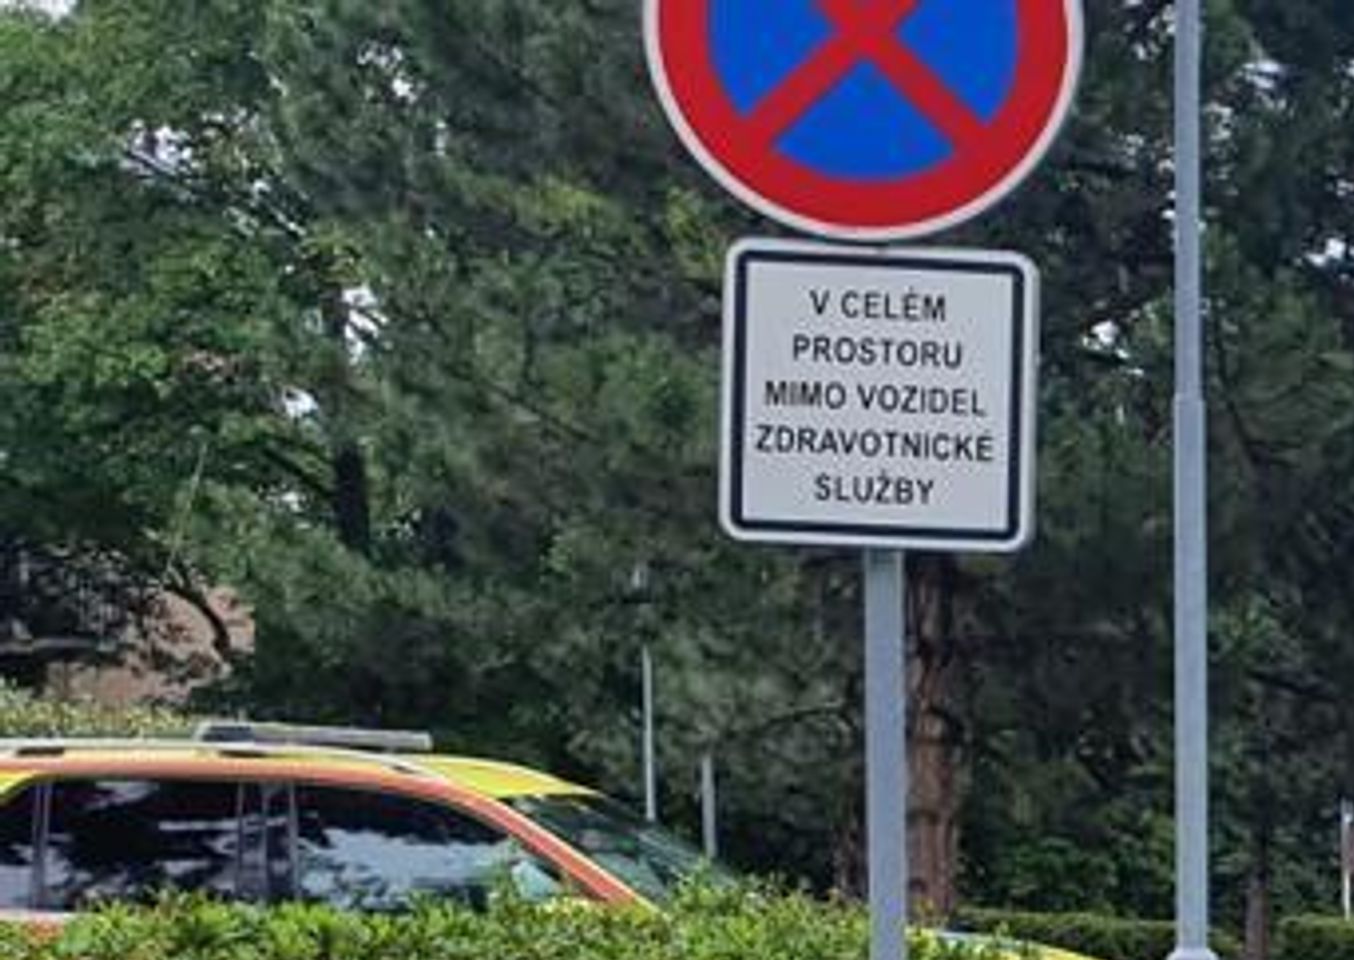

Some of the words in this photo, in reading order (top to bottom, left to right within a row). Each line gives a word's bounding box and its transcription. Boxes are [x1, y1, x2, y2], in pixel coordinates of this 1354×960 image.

[810, 289, 830, 316] V
[841, 286, 946, 322] CELÉM
[792, 334, 963, 369] PROSTORU
[765, 380, 847, 410] MIMO
[857, 383, 987, 417] VOZIDEL
[755, 424, 995, 462] ZDRAVOTNICKÉ
[814, 470, 935, 505] SLUŽBY
